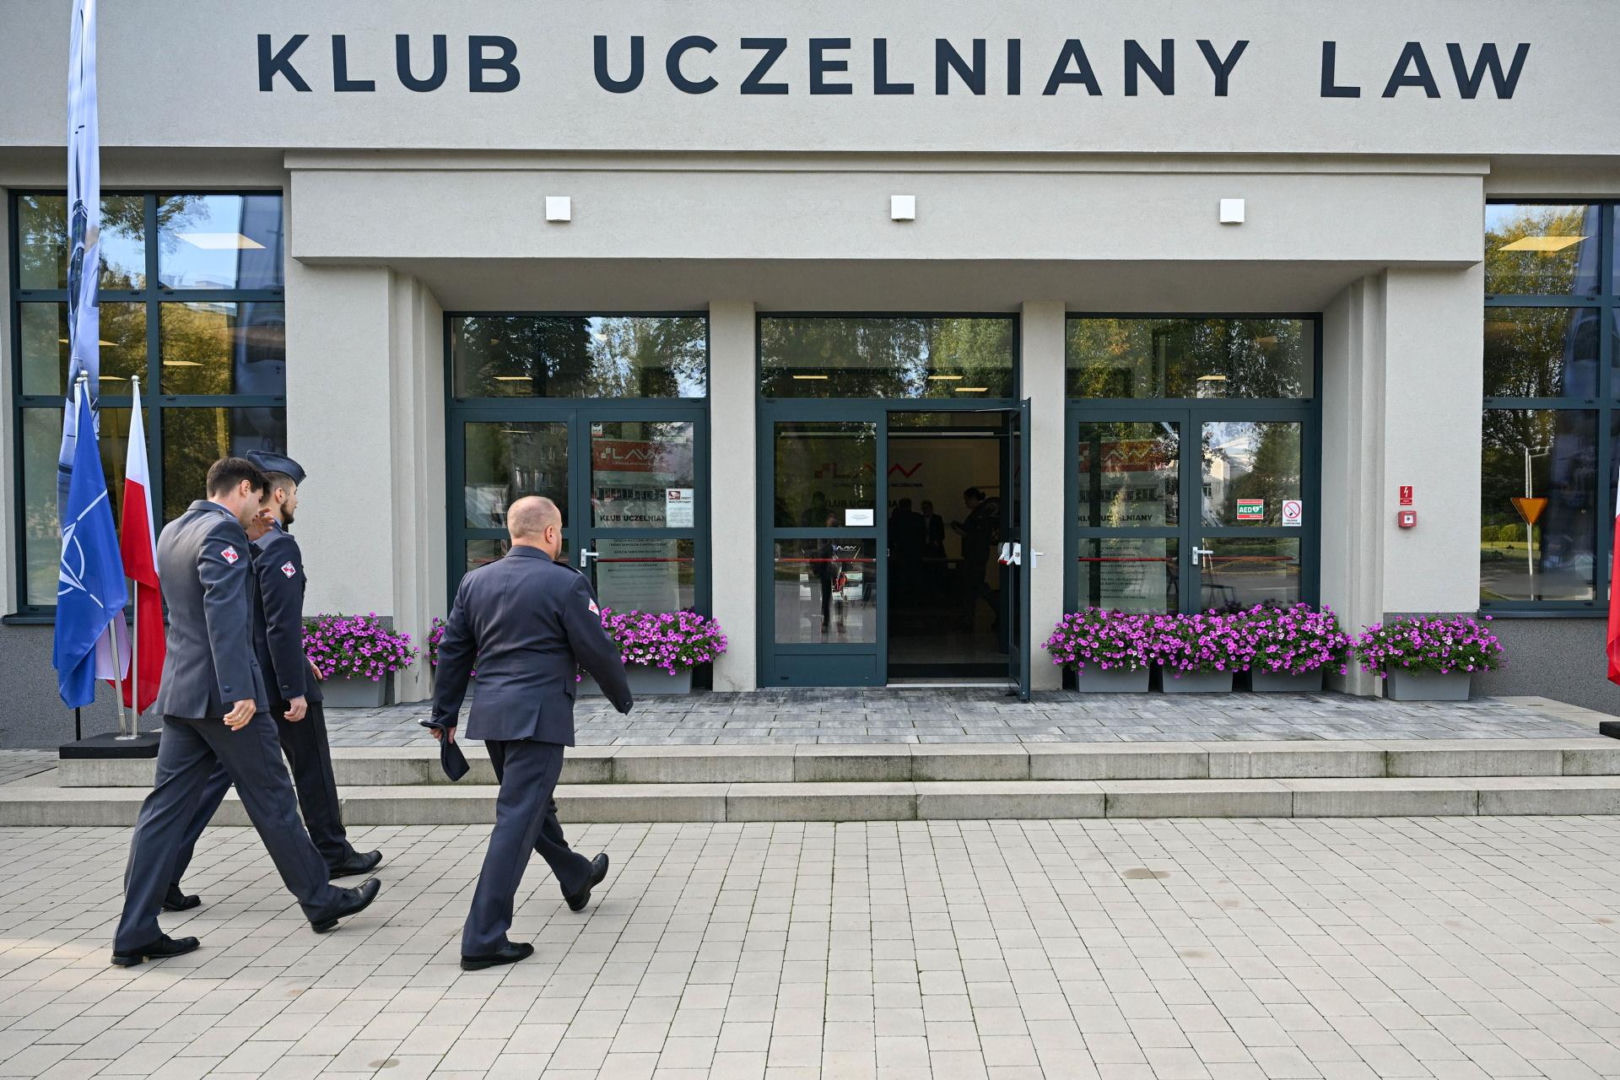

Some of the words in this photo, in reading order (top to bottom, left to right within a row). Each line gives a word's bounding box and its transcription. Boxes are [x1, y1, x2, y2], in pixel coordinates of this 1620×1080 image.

[258, 34, 520, 93] KLUB
[594, 35, 1249, 97] UCZELNIANY
[1321, 41, 1530, 100] LAW
[600, 514, 621, 522] KLUB
[624, 514, 666, 522] UCZELNIAN
